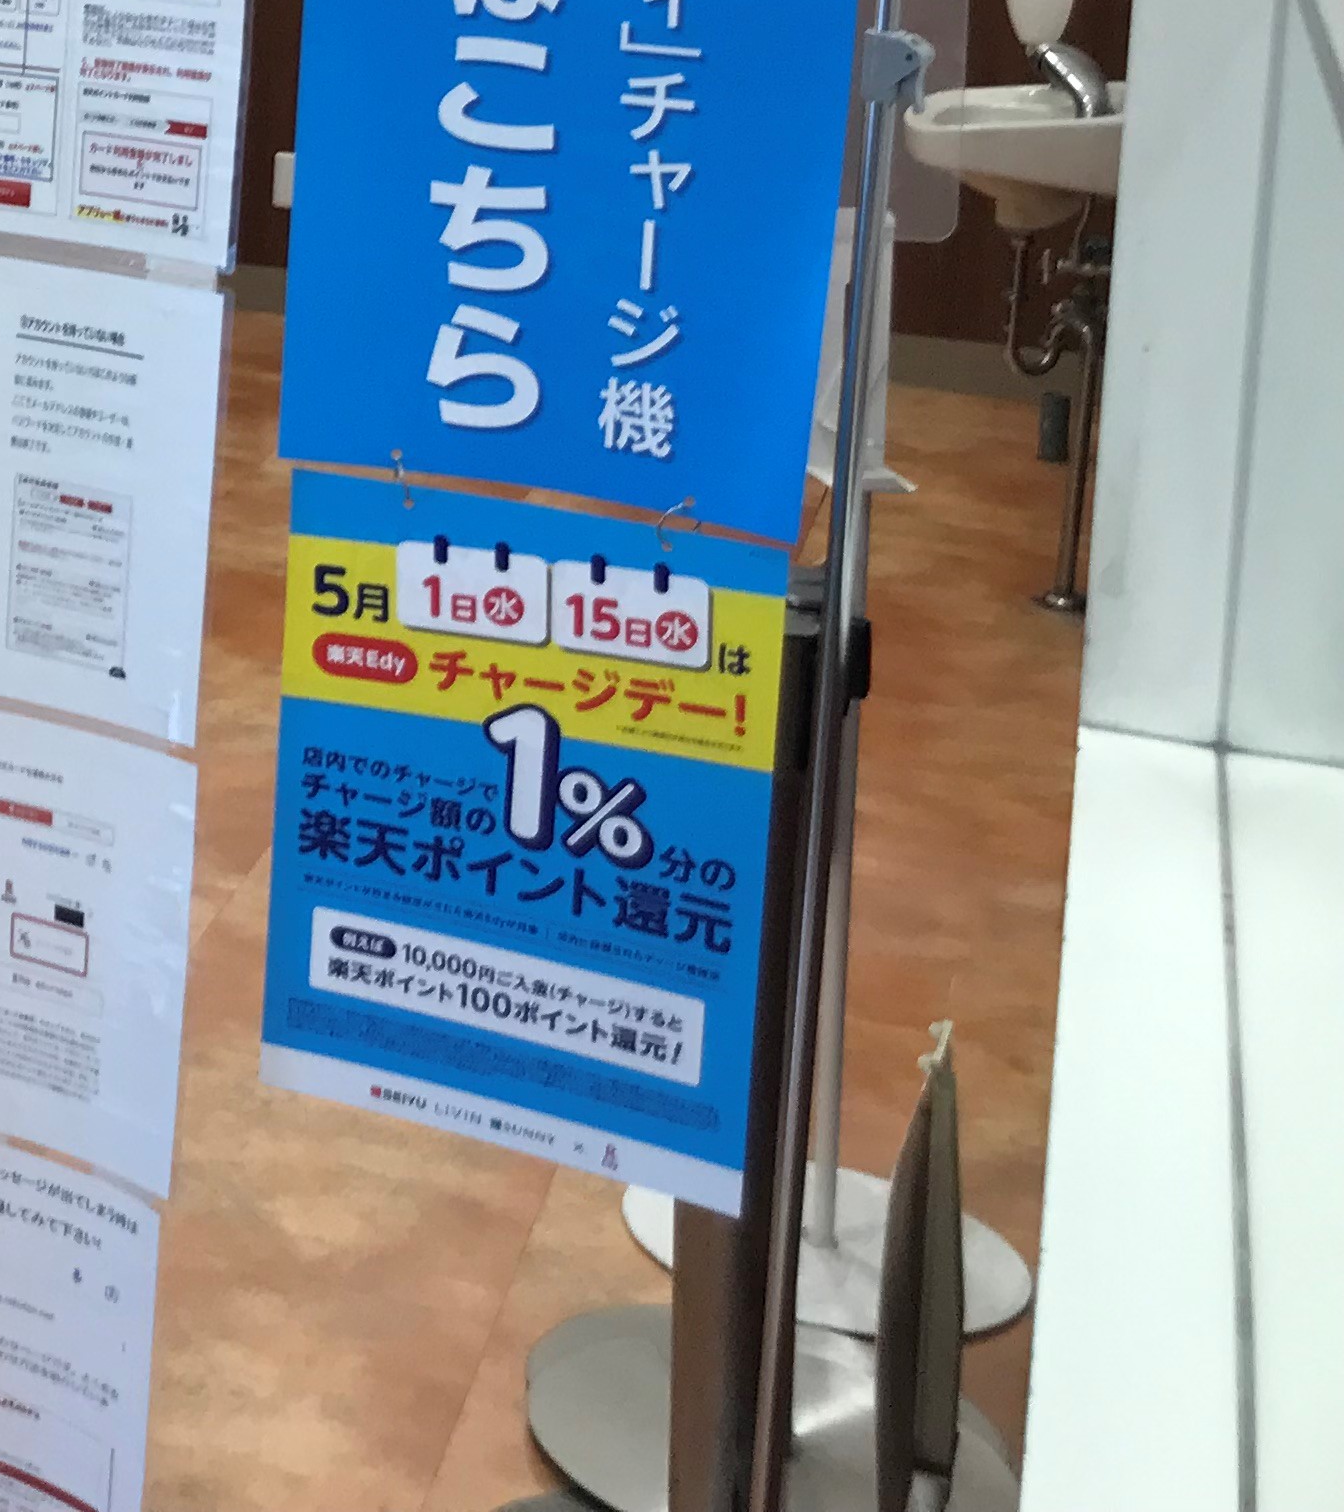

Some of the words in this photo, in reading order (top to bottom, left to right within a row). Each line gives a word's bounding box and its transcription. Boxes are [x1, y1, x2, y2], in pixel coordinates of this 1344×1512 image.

[312, 564, 390, 623] 5月
[326, 646, 406, 675] 楽天Edy
[302, 746, 500, 800] 店内でのチャージで
[300, 775, 495, 836] チャージ額の
[297, 808, 734, 954] 楽天ポイント還元
[659, 847, 736, 890] 分の
